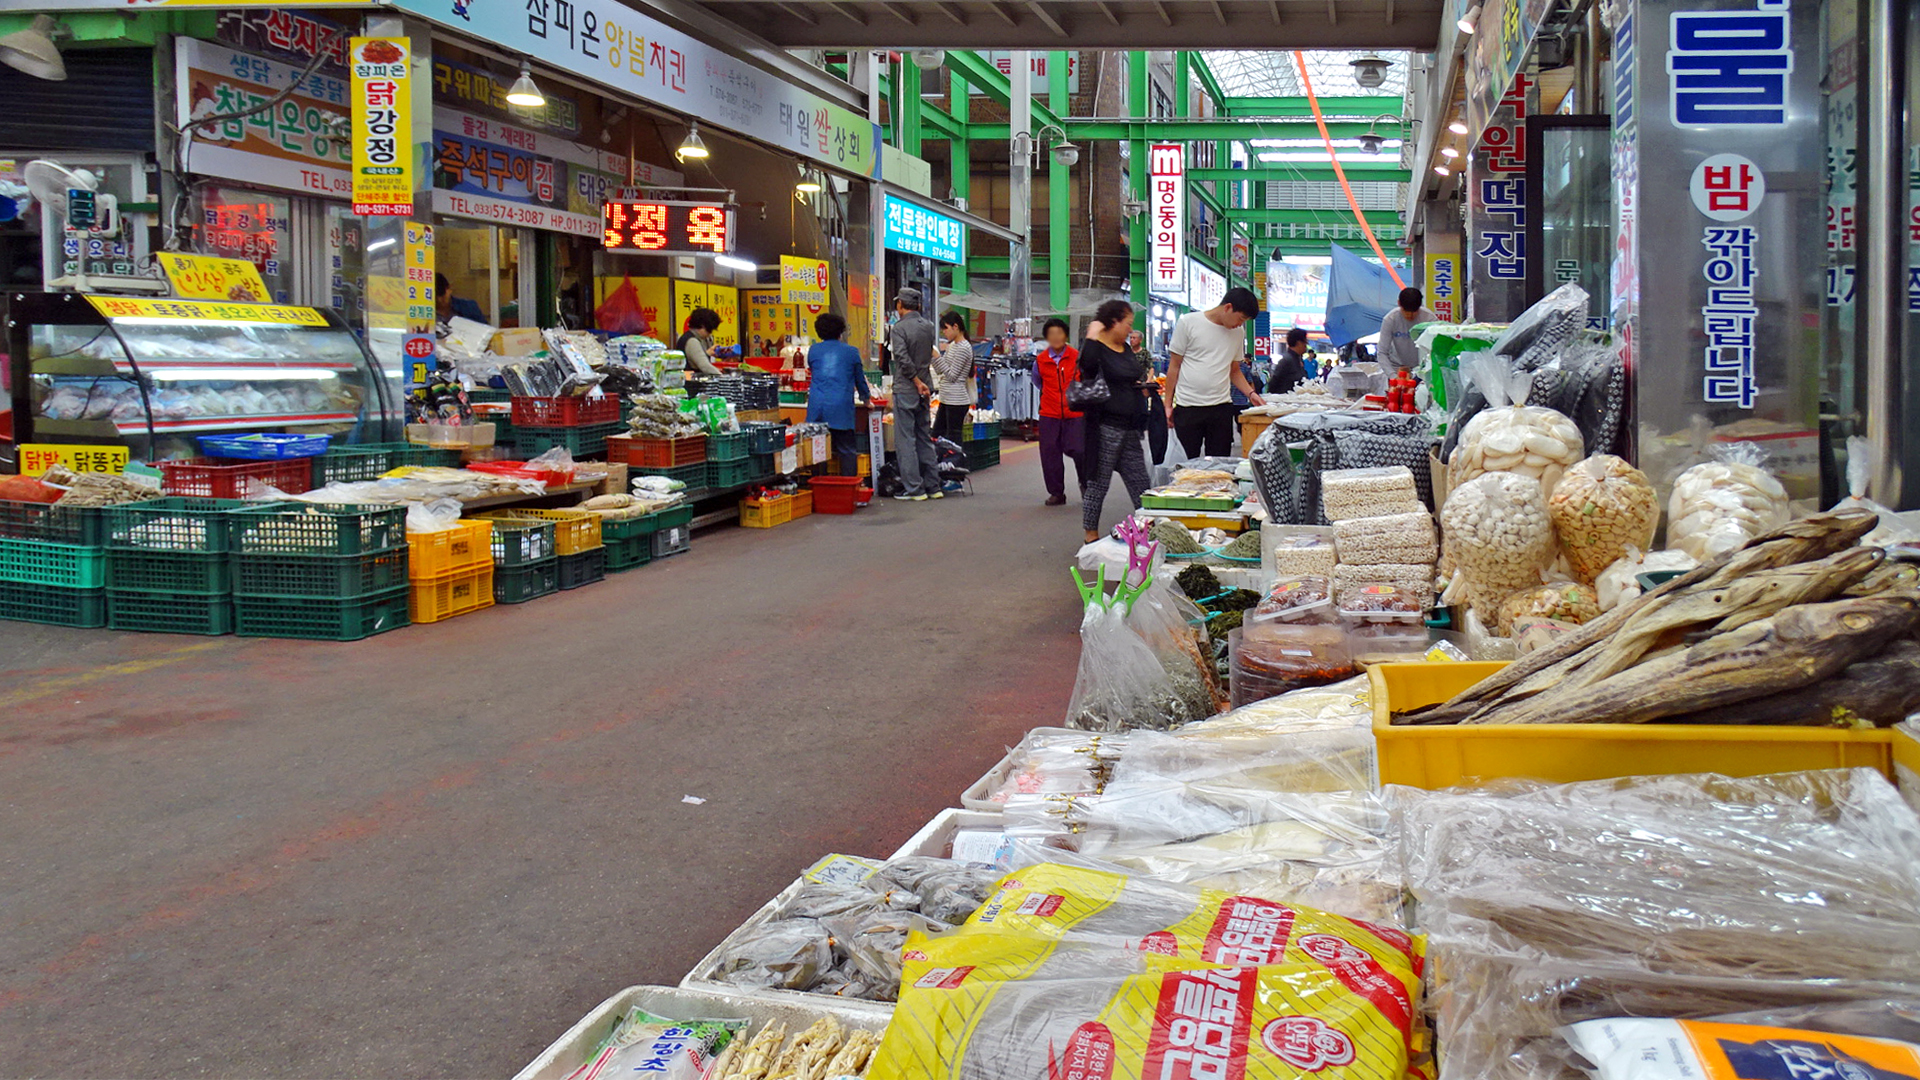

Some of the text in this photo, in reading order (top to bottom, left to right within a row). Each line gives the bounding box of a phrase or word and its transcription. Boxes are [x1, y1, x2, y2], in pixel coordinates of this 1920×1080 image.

[265, 8, 351, 66] 산지직
[355, 64, 405, 77] 참피온
[215, 83, 351, 163] 참피온양
[366, 81, 397, 163] 닭강정
[462, 116, 536, 151] 돌김 재래김
[1704, 164, 1753, 212] 밤
[687, 206, 727, 252] 육
[884, 194, 960, 248] 전문할인매장
[1157, 181, 1177, 280] 명동의류
[408, 286, 433, 300] 오리
[1435, 259, 1452, 298] 옥수수
[104, 300, 321, 323] 생닭 토종닭 생오리 (국내산)
[25, 450, 128, 474] 닭발 닭똥집
[1284, 1023, 1311, 1059] 오뚜기
